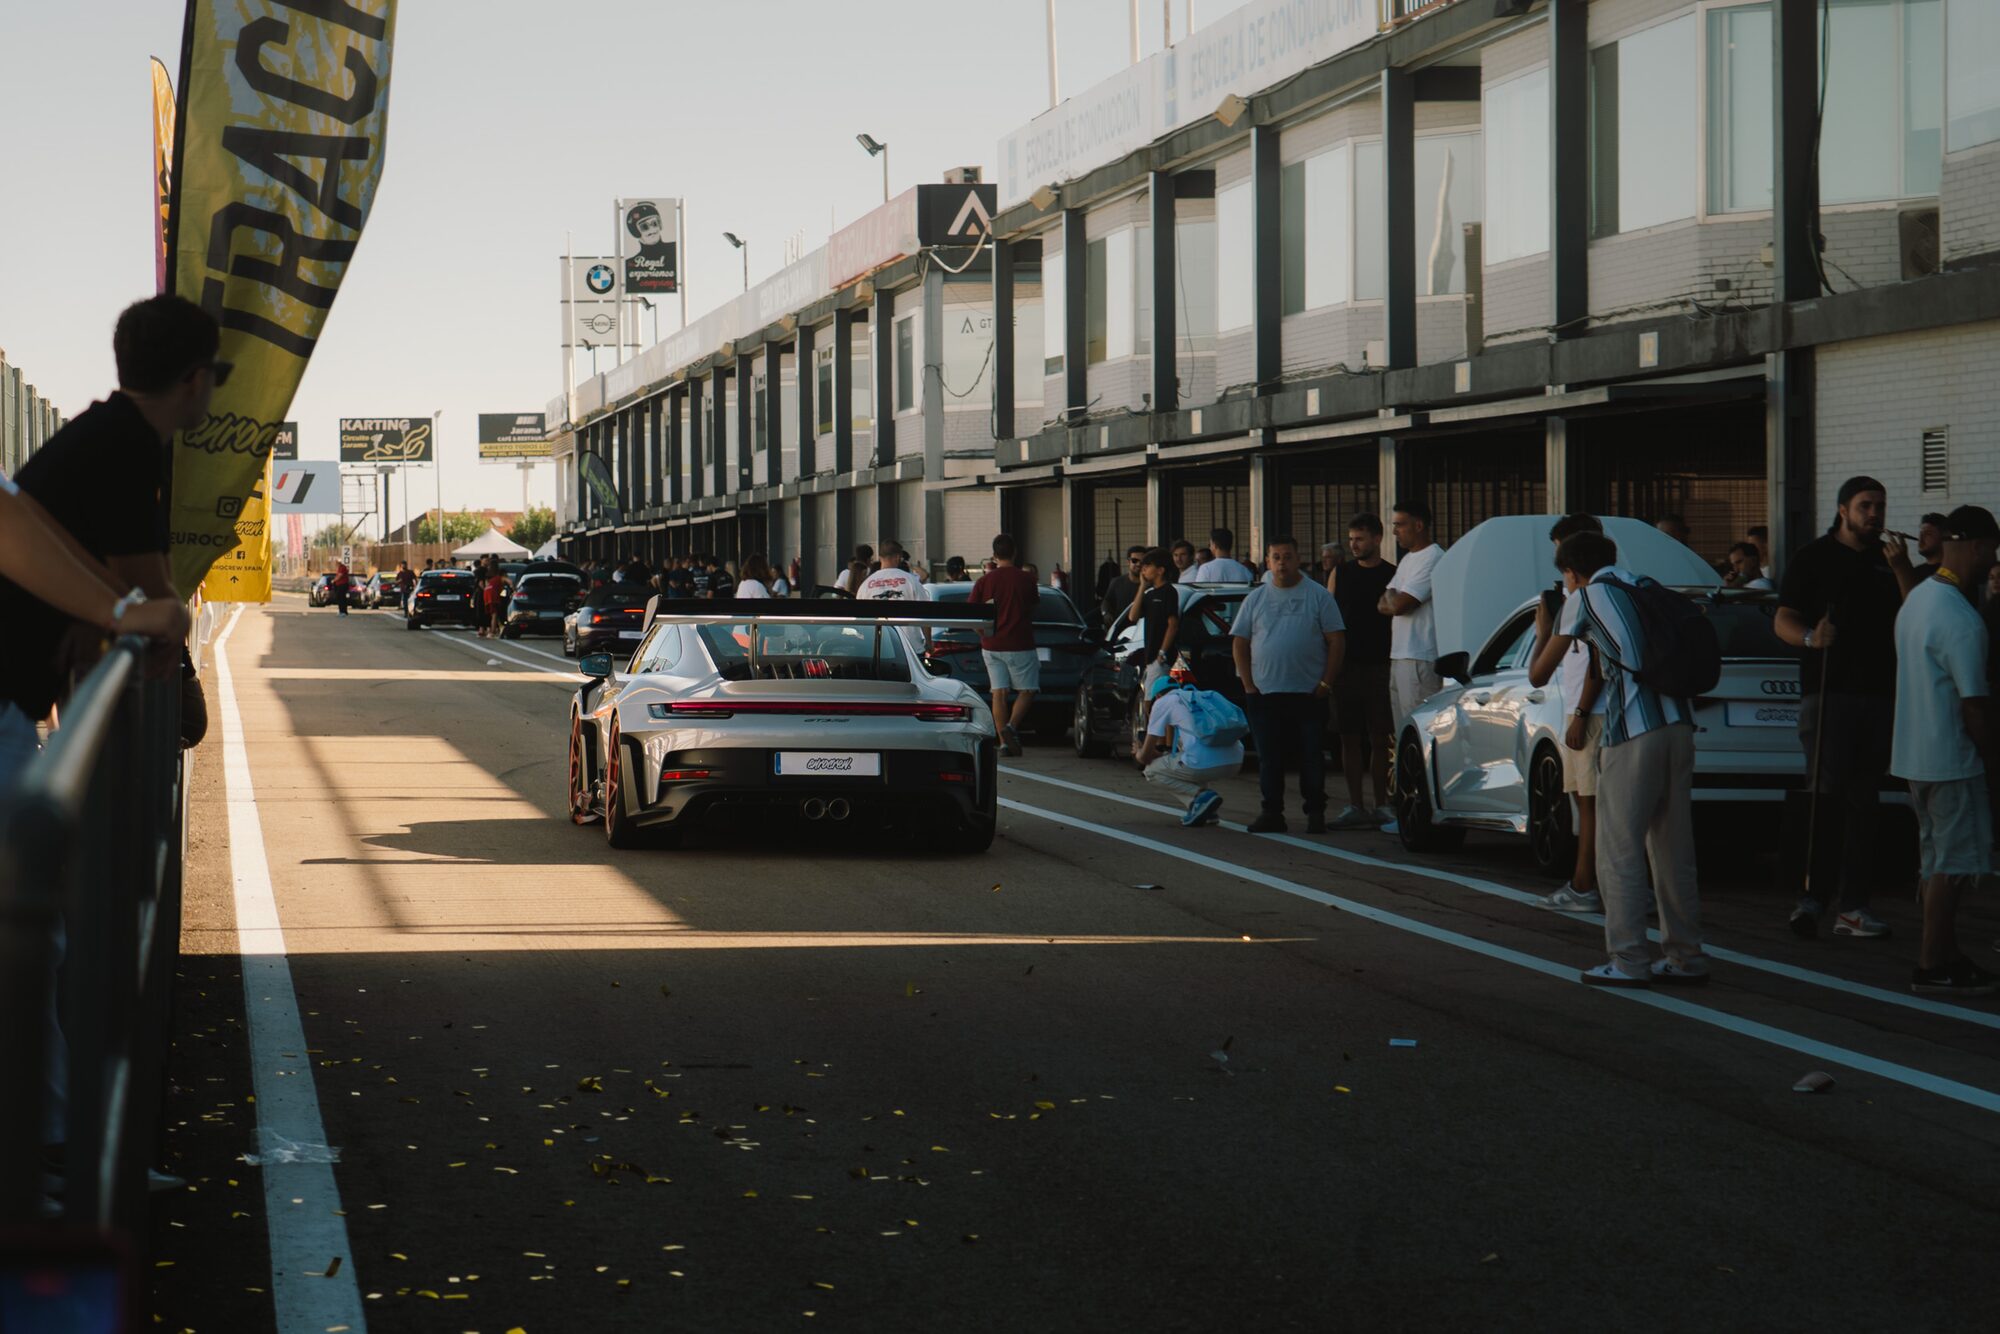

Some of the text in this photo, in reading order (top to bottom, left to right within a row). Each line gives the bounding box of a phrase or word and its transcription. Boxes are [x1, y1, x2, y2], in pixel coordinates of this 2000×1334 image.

[1191, 28, 1244, 100] ESCUELA
[1249, 16, 1265, 72] DE
[1026, 122, 1061, 179] ESCUELA
[1064, 116, 1076, 161] DE
[199, 0, 385, 358] TRAC
[341, 419, 410, 432] KARTING
[168, 531, 229, 548] EUROC
[868, 577, 906, 589] Garage
